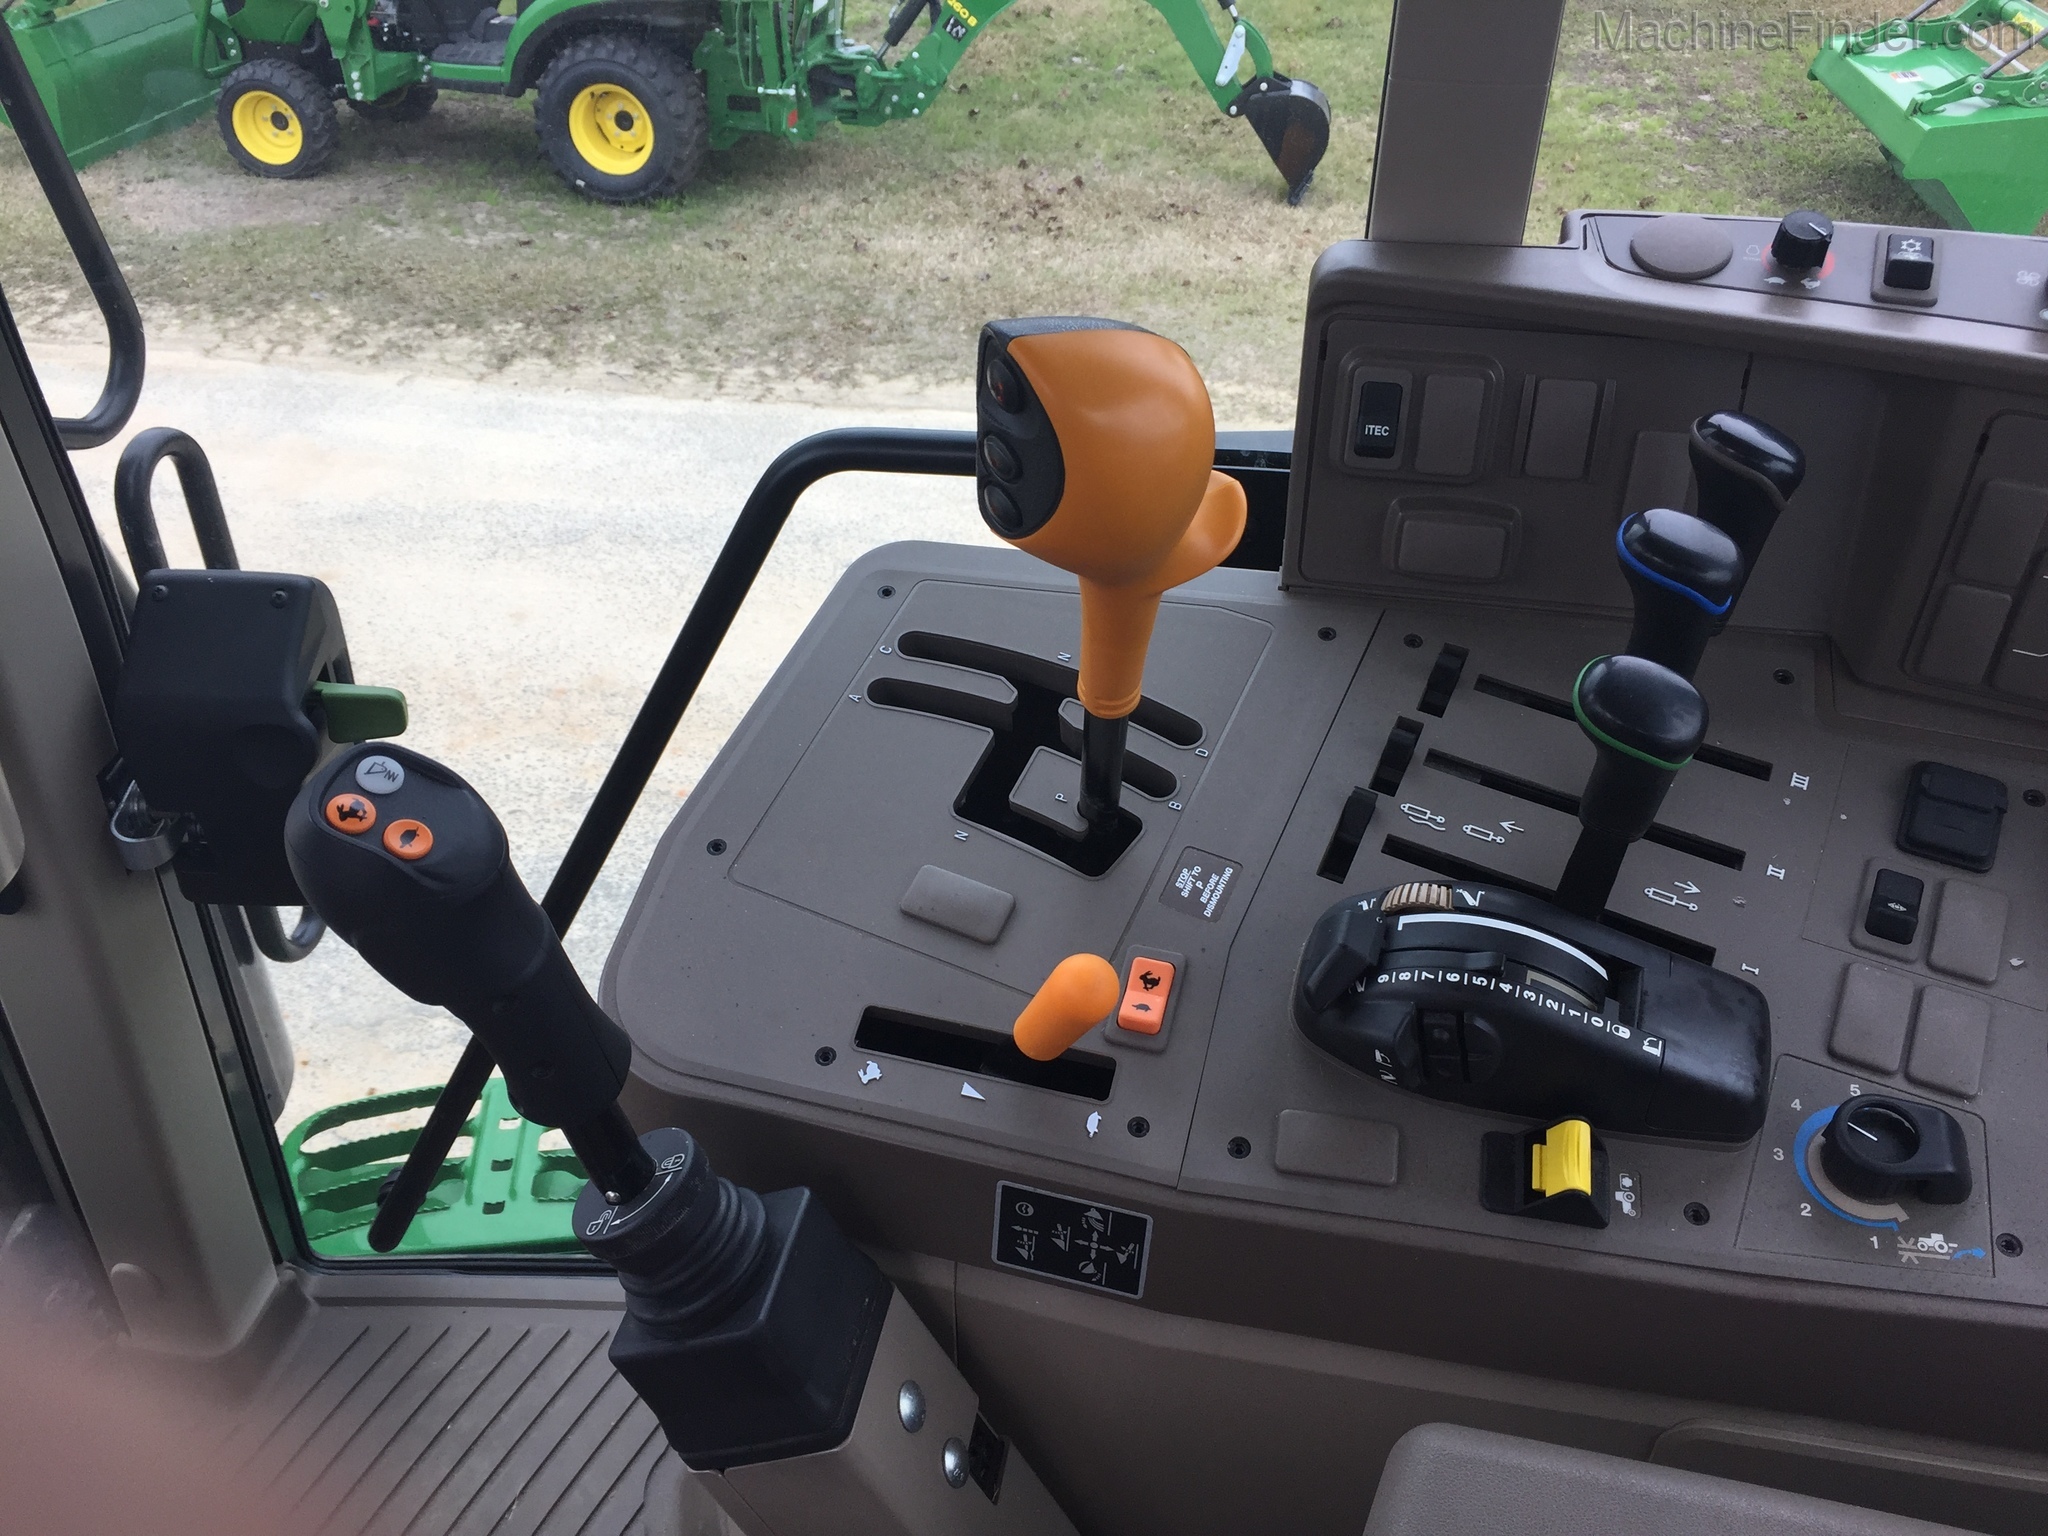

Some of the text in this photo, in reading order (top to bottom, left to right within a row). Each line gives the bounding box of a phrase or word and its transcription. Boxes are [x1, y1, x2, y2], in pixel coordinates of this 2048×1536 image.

[1365, 424, 1389, 436] iTEC
[880, 645, 892, 654] C
[1057, 652, 1072, 662] N
[849, 693, 862, 702] A
[1195, 748, 1208, 758] D
[1055, 793, 1068, 803] P
[1168, 801, 1182, 811] B
[954, 829, 969, 841] N
[1175, 868, 1191, 889] STOP
[1181, 865, 1202, 898] SHIFT TO
[1196, 880, 1204, 890] P
[1200, 873, 1220, 904] BEFORE
[1203, 867, 1233, 917] DISMOUNTING
[1378, 971, 1604, 1027] 9 8 7 6 5 4 3 2 1 0
[1850, 1085, 1861, 1096] 5
[1790, 1099, 1802, 1111] 4
[1773, 1148, 1785, 1161] 3
[1800, 1203, 1812, 1216] 2
[1870, 1236, 1879, 1249] 1
